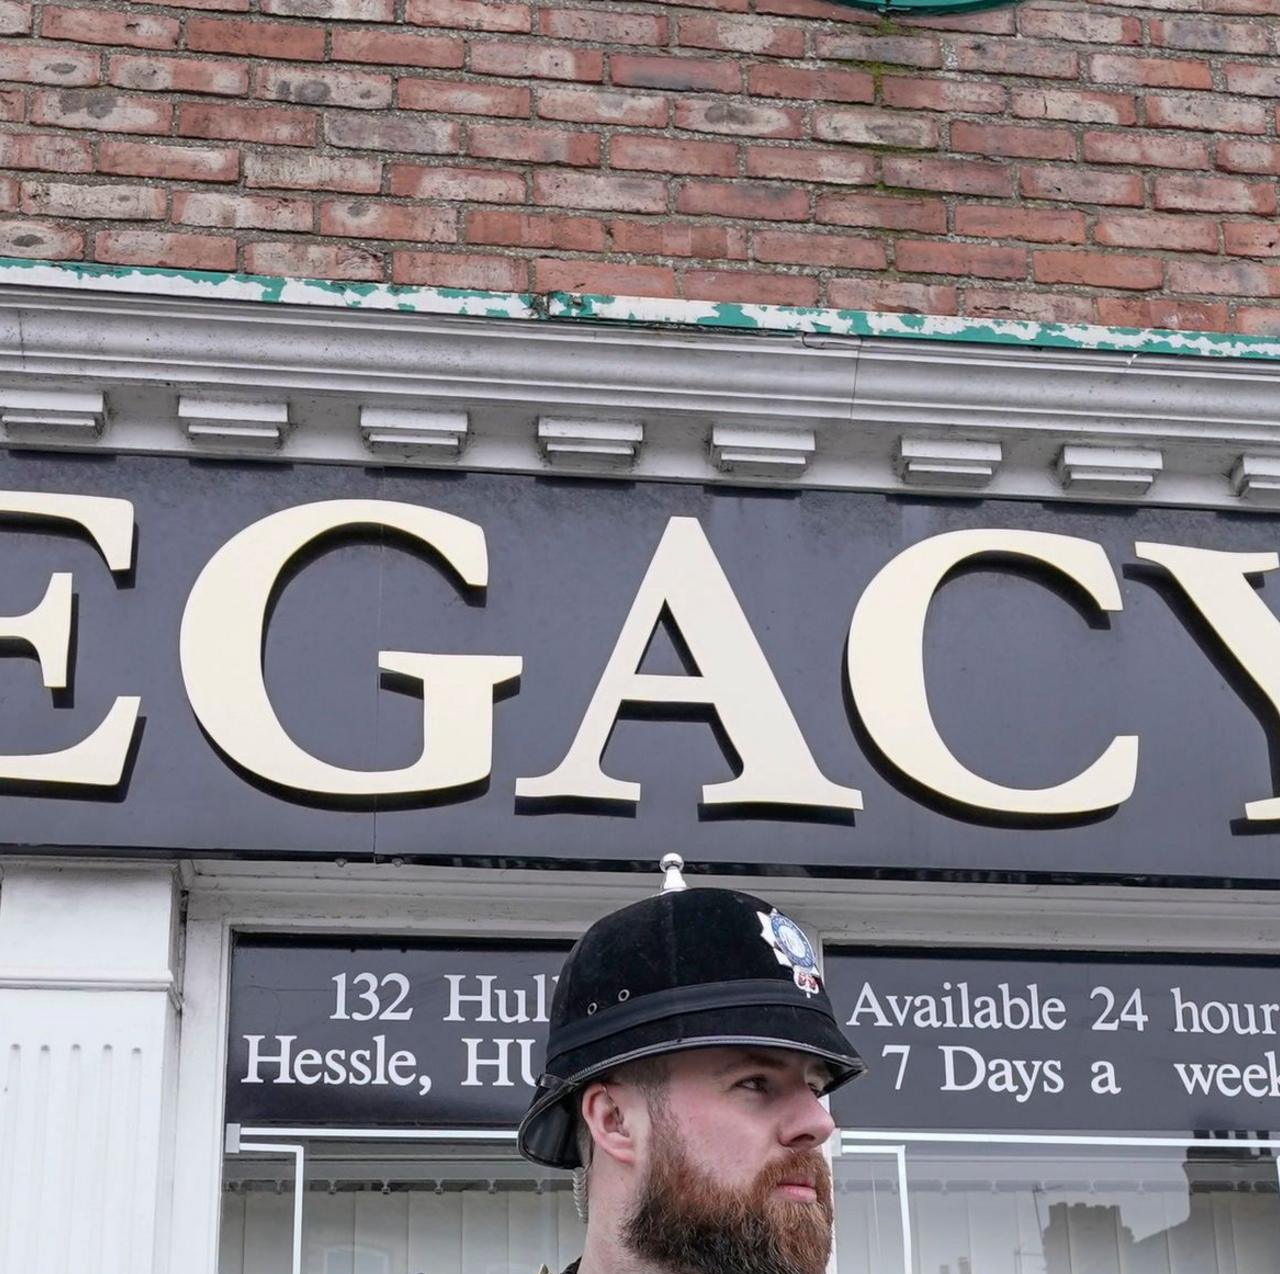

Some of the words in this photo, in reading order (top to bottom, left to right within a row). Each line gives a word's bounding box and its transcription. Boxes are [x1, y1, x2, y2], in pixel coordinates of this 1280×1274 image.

[329, 972, 414, 1022] 132
[442, 973, 560, 1024] Hul
[845, 981, 1068, 1031] Available
[1089, 986, 1149, 1033] 24
[240, 1034, 432, 1096] Hessle,
[881, 1044, 911, 1090] 7
[937, 1045, 1065, 1103] Days
[1090, 1060, 1122, 1095] a
